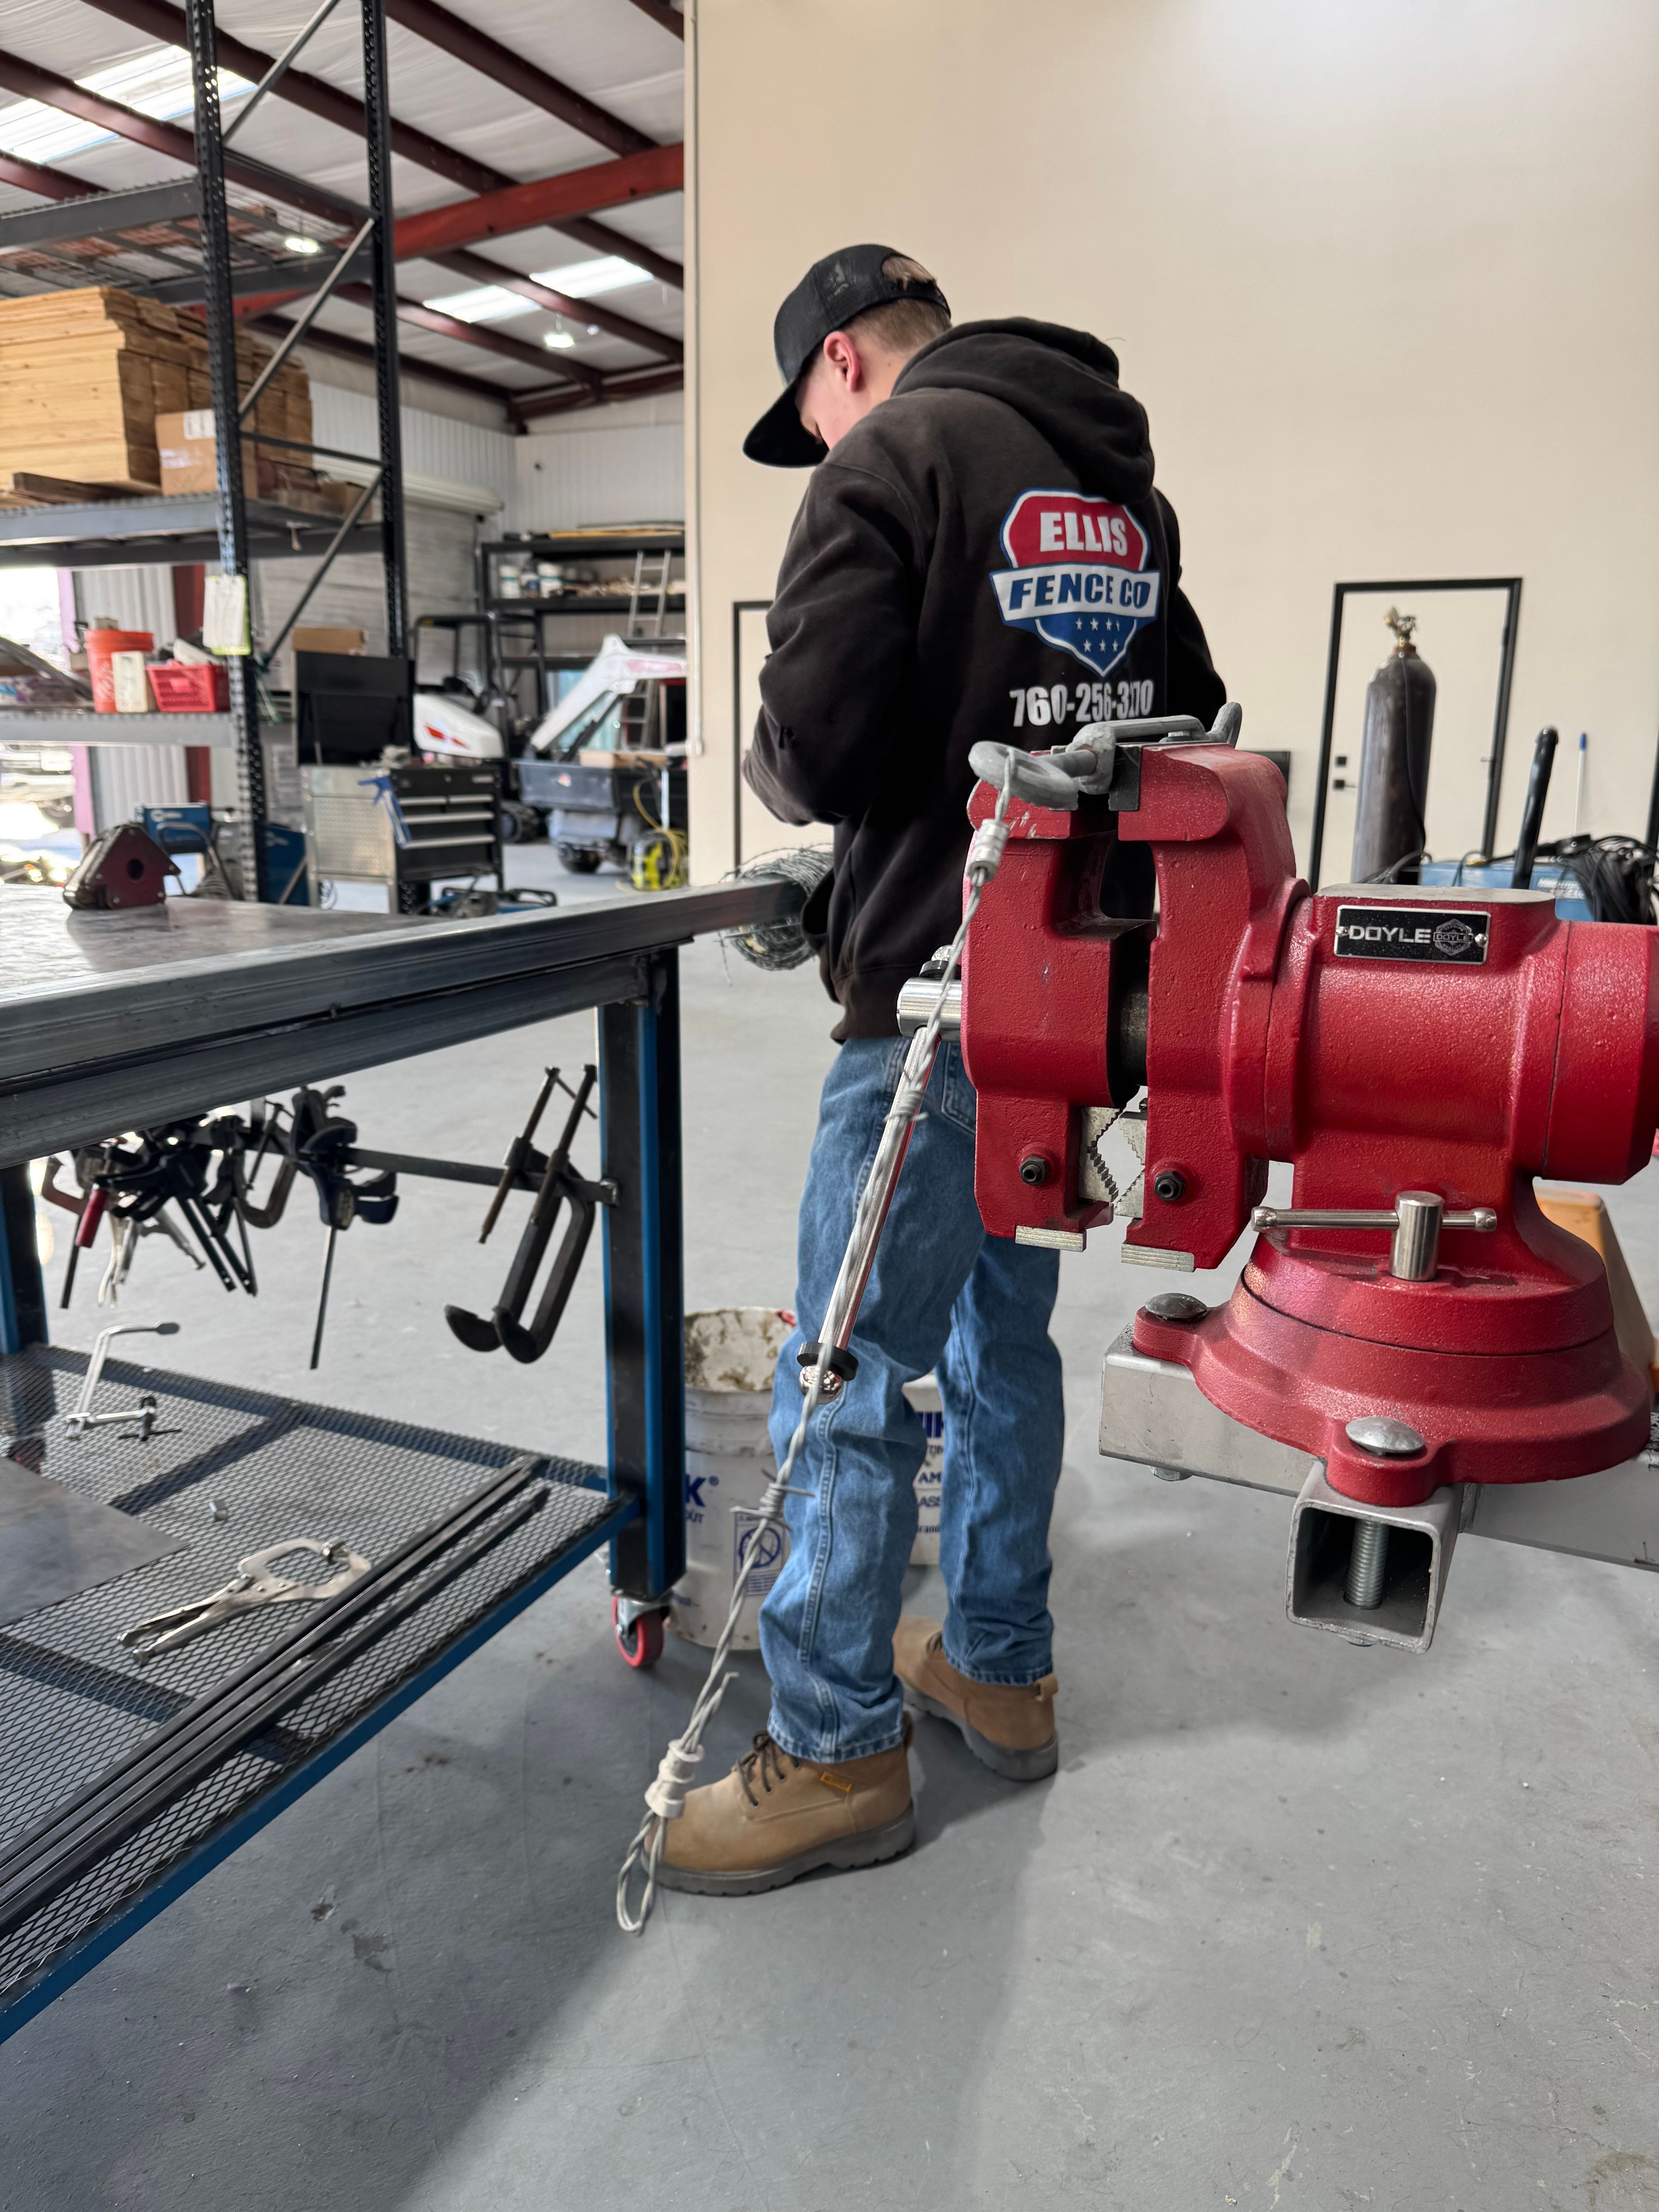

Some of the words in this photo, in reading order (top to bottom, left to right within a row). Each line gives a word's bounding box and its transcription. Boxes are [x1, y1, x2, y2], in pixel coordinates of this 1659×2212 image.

[1040, 512, 1128, 556] ELLIS
[1009, 573, 1113, 610] FENCE
[1120, 579, 1151, 608] CO
[1349, 925, 1431, 943] DOYLE
